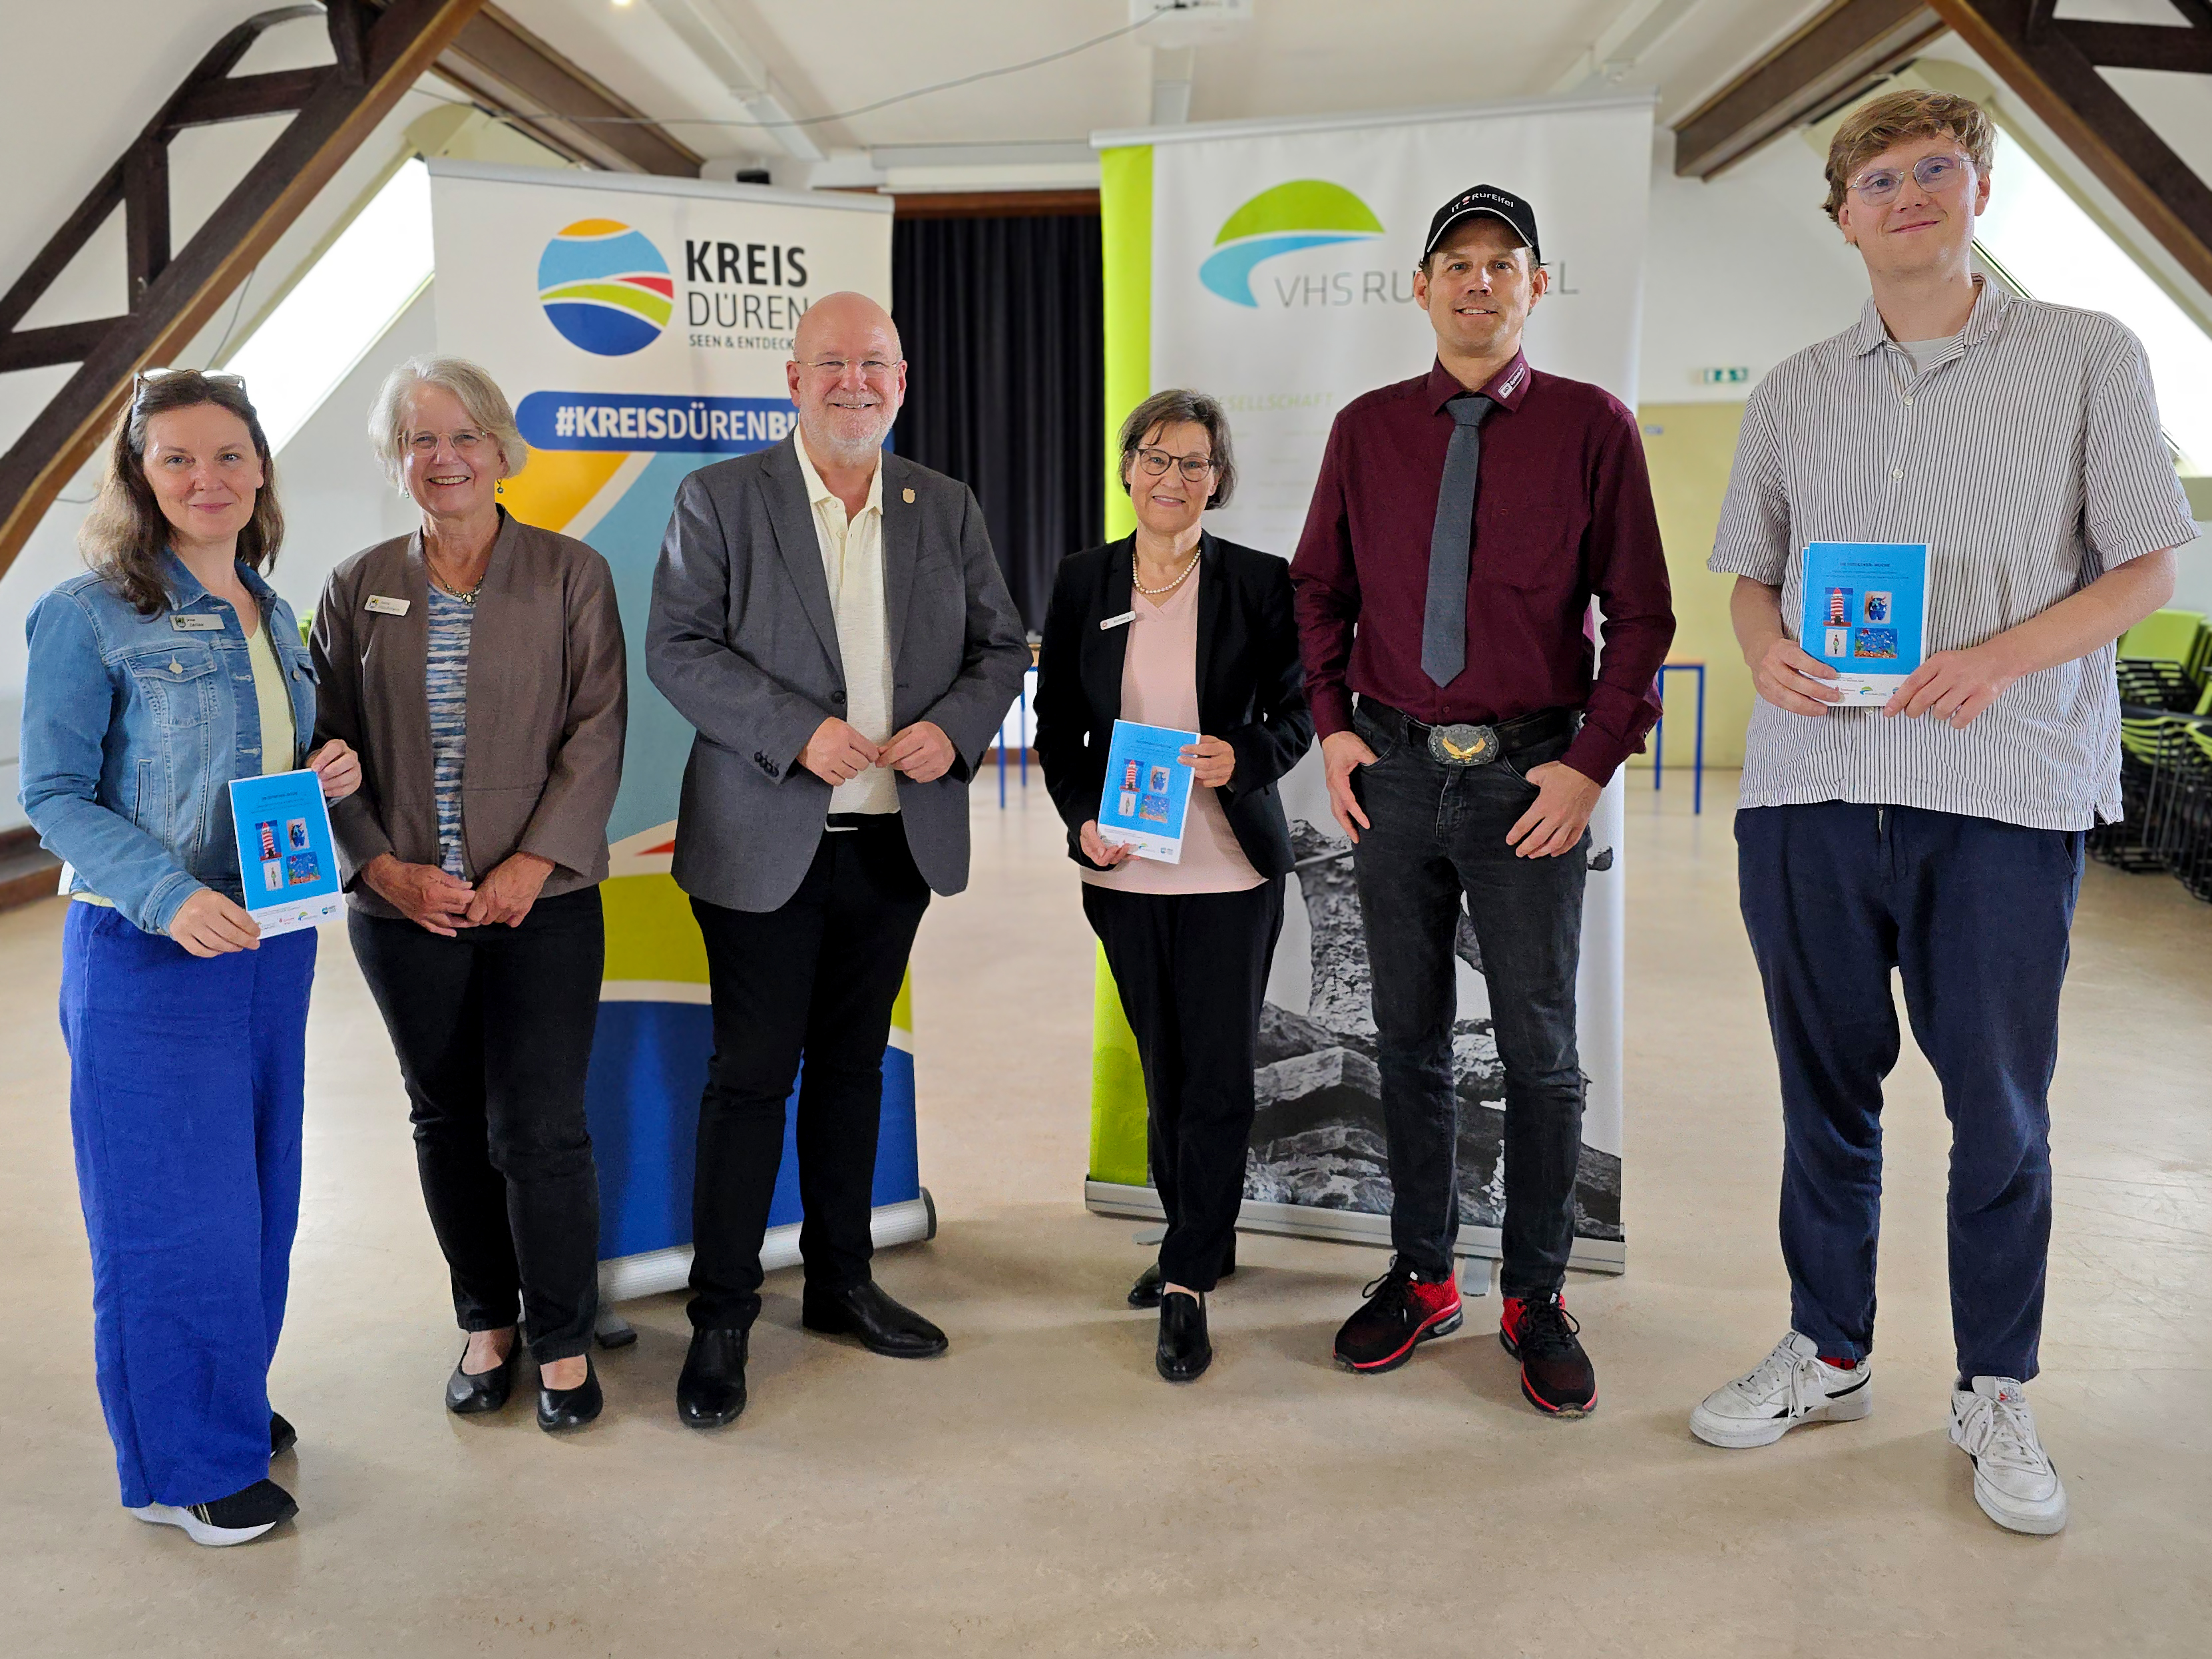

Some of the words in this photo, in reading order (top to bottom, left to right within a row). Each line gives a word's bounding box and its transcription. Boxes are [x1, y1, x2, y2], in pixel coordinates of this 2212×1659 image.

[1451, 202, 1461, 213] IT
[686, 240, 807, 288] KREIS
[1274, 271, 1353, 308] VHS
[688, 292, 808, 330] DÜREN
[690, 335, 721, 347] SEEN
[724, 336, 735, 348] &
[738, 336, 794, 351] ENTDECK
